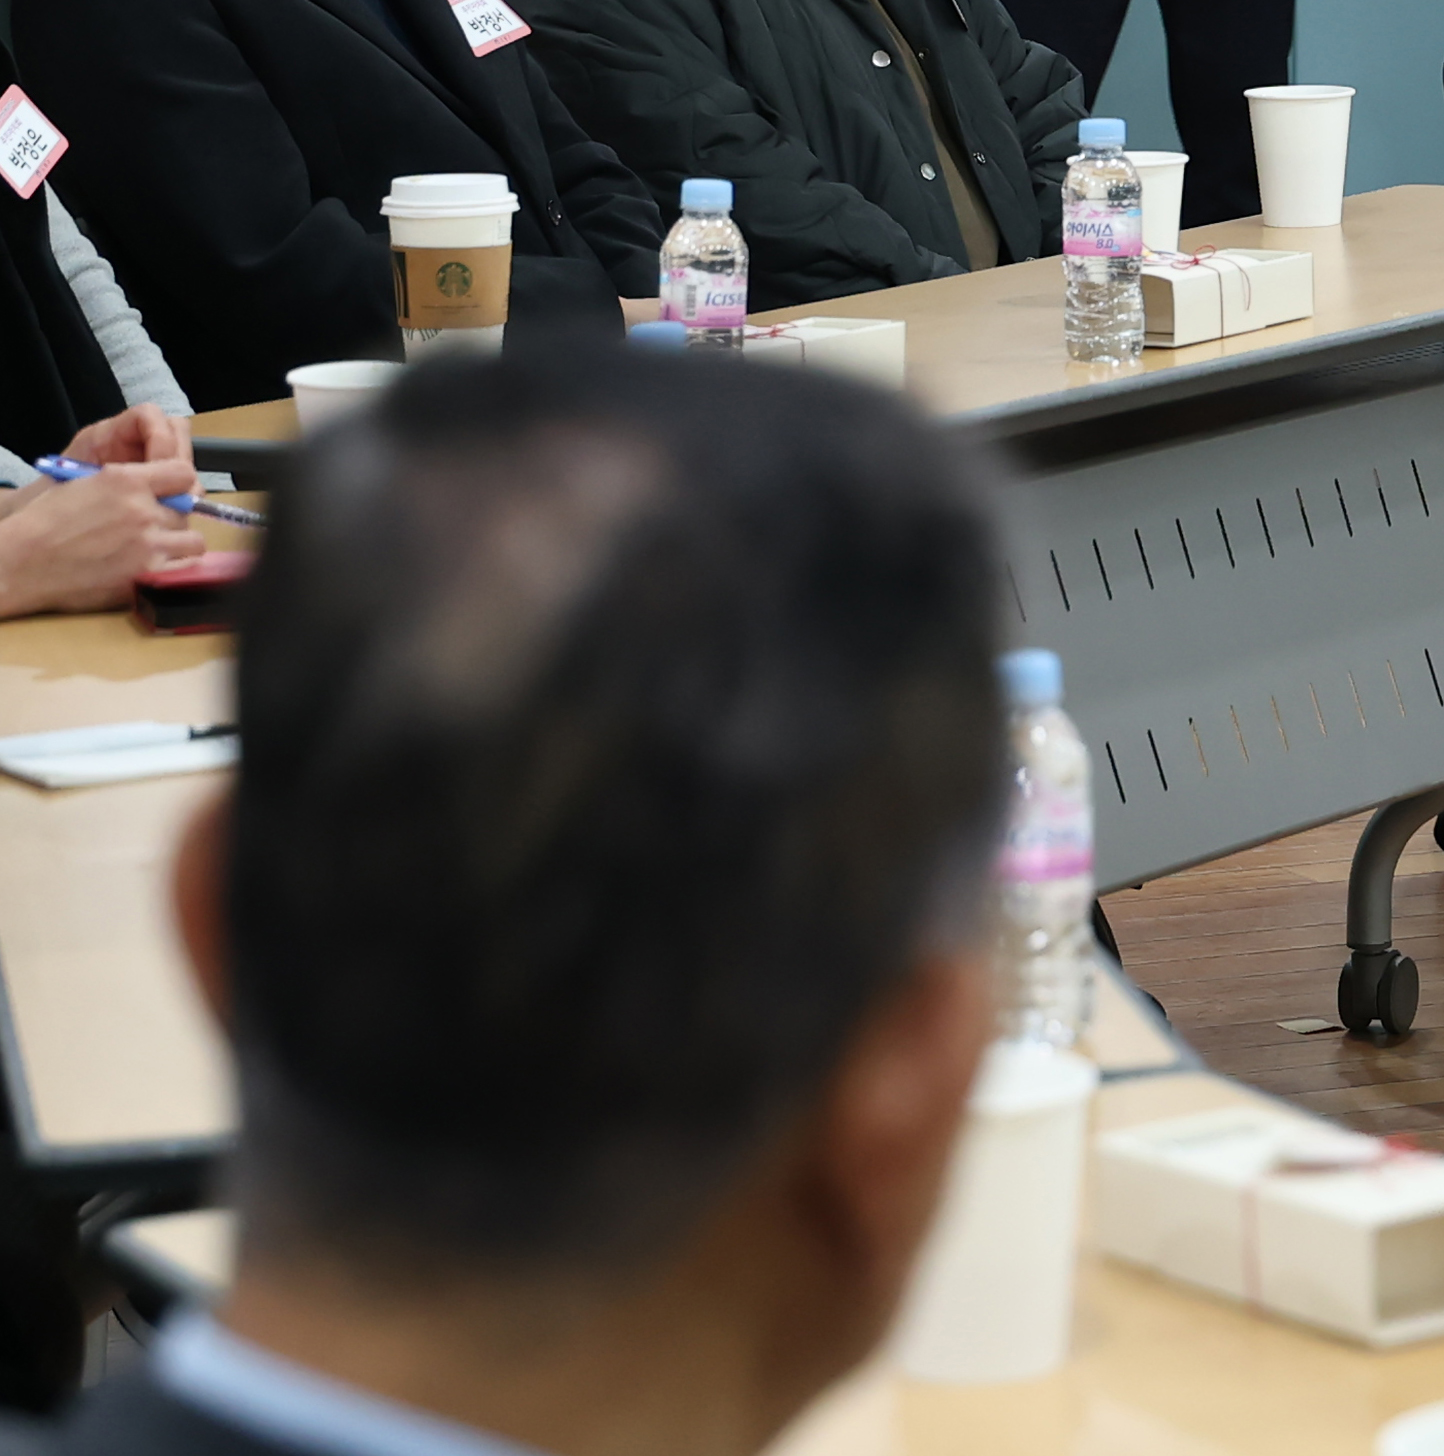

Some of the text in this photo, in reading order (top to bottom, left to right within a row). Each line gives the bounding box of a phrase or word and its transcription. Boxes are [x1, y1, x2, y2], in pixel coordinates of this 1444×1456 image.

[467, 7, 512, 36] 박정서
[8, 128, 48, 170] 박정은
[1066, 221, 1114, 238] 아이시스
